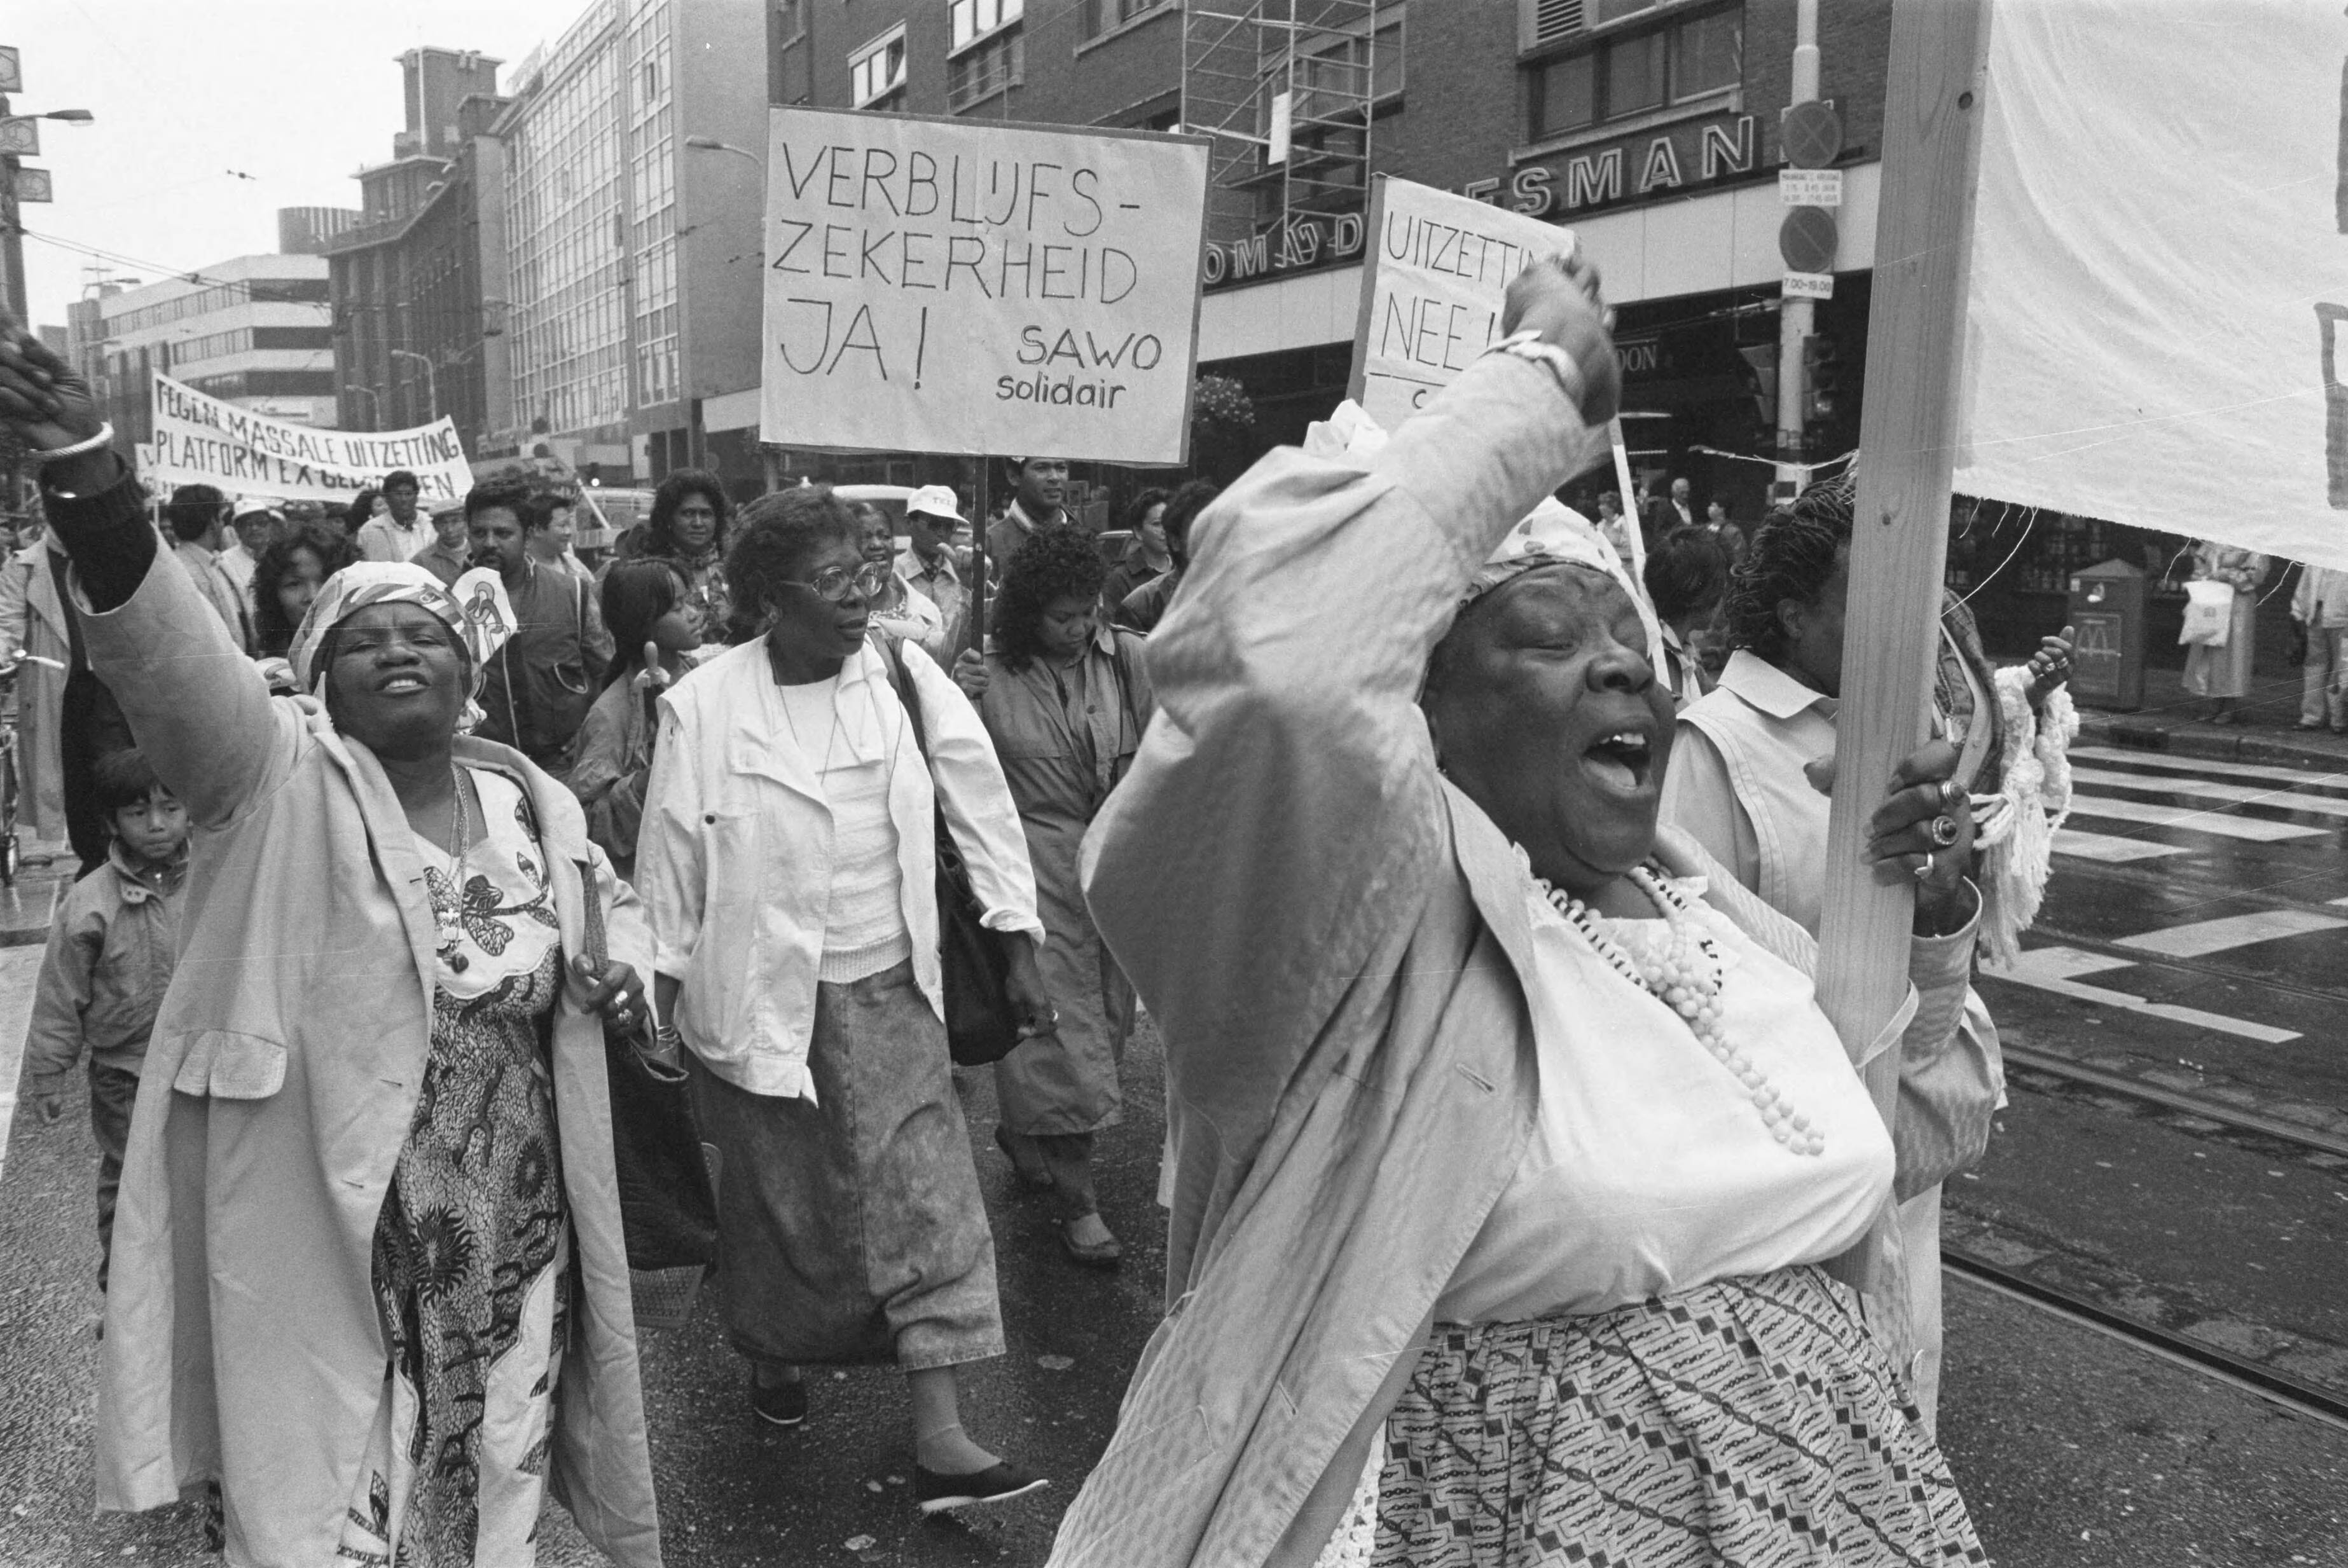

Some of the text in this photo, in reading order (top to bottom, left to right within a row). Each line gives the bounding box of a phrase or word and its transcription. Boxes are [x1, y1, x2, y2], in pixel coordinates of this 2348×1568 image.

[772, 219, 1138, 305] ZEKERHEID
[1387, 210, 1535, 289] UITZETTI
[1017, 325, 1163, 371] SAWO
[156, 379, 460, 468] TEGEN MASSALE UITZETTING
[156, 429, 268, 481] PLATFORM
